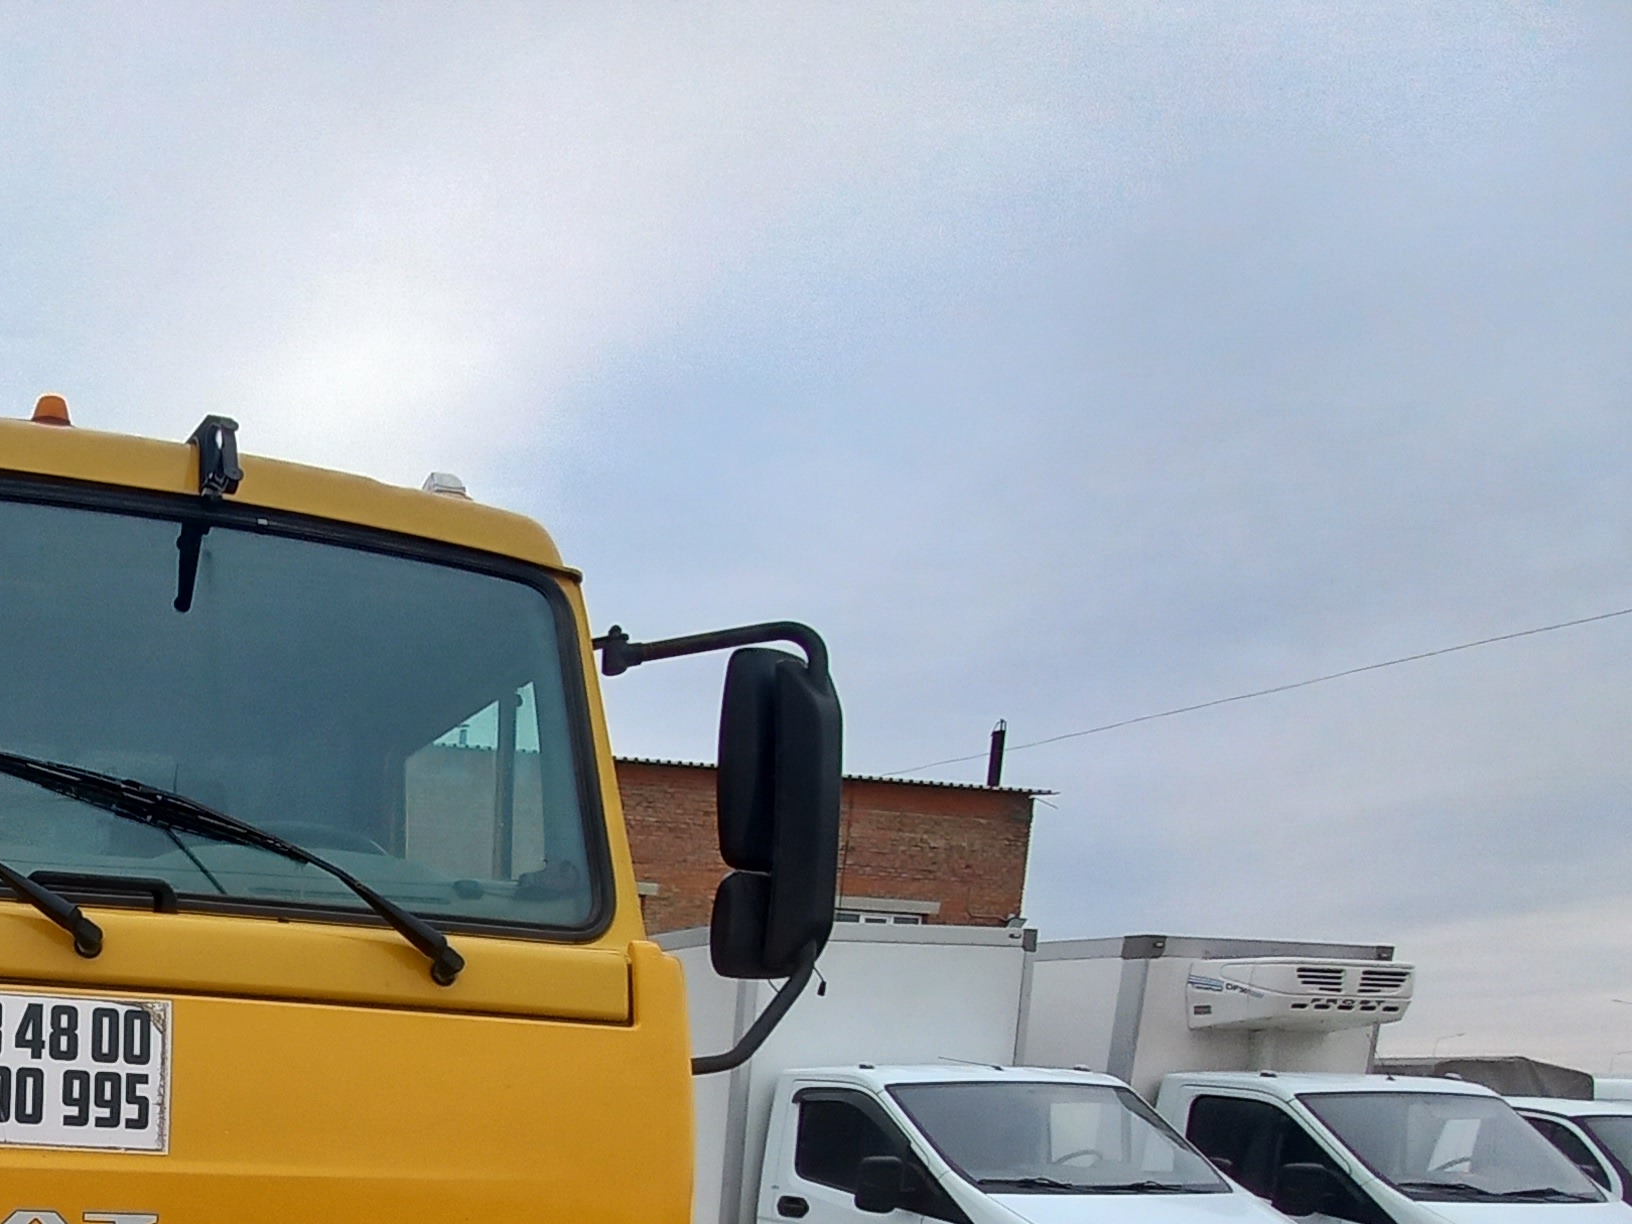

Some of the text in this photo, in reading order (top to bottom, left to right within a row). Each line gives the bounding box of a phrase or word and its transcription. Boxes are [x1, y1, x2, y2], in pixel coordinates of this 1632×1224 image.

[15, 1002, 79, 1061] 48
[91, 1007, 151, 1065] 00
[62, 1070, 150, 1130] 995
